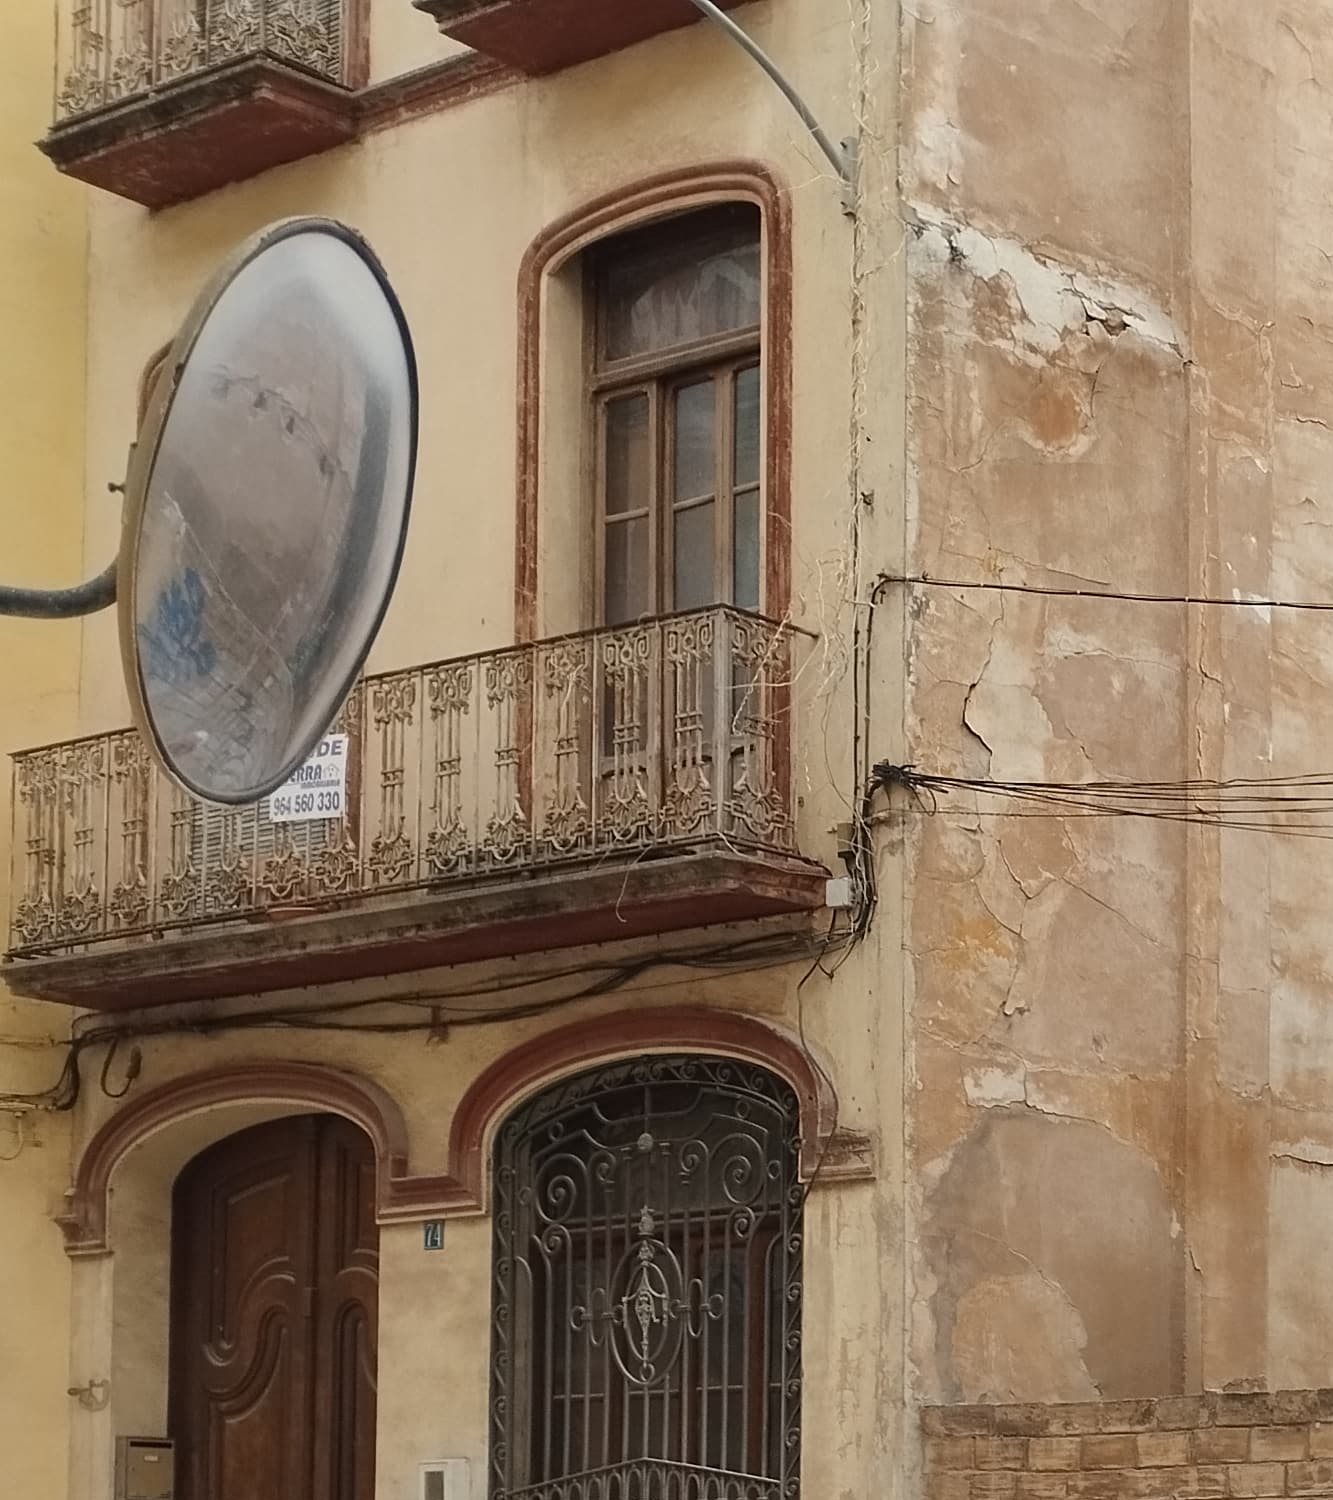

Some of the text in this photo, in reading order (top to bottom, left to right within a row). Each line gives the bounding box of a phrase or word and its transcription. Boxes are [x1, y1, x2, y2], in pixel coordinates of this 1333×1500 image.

[273, 791, 340, 817] 964 560 330
[426, 1222, 441, 1247] 74
